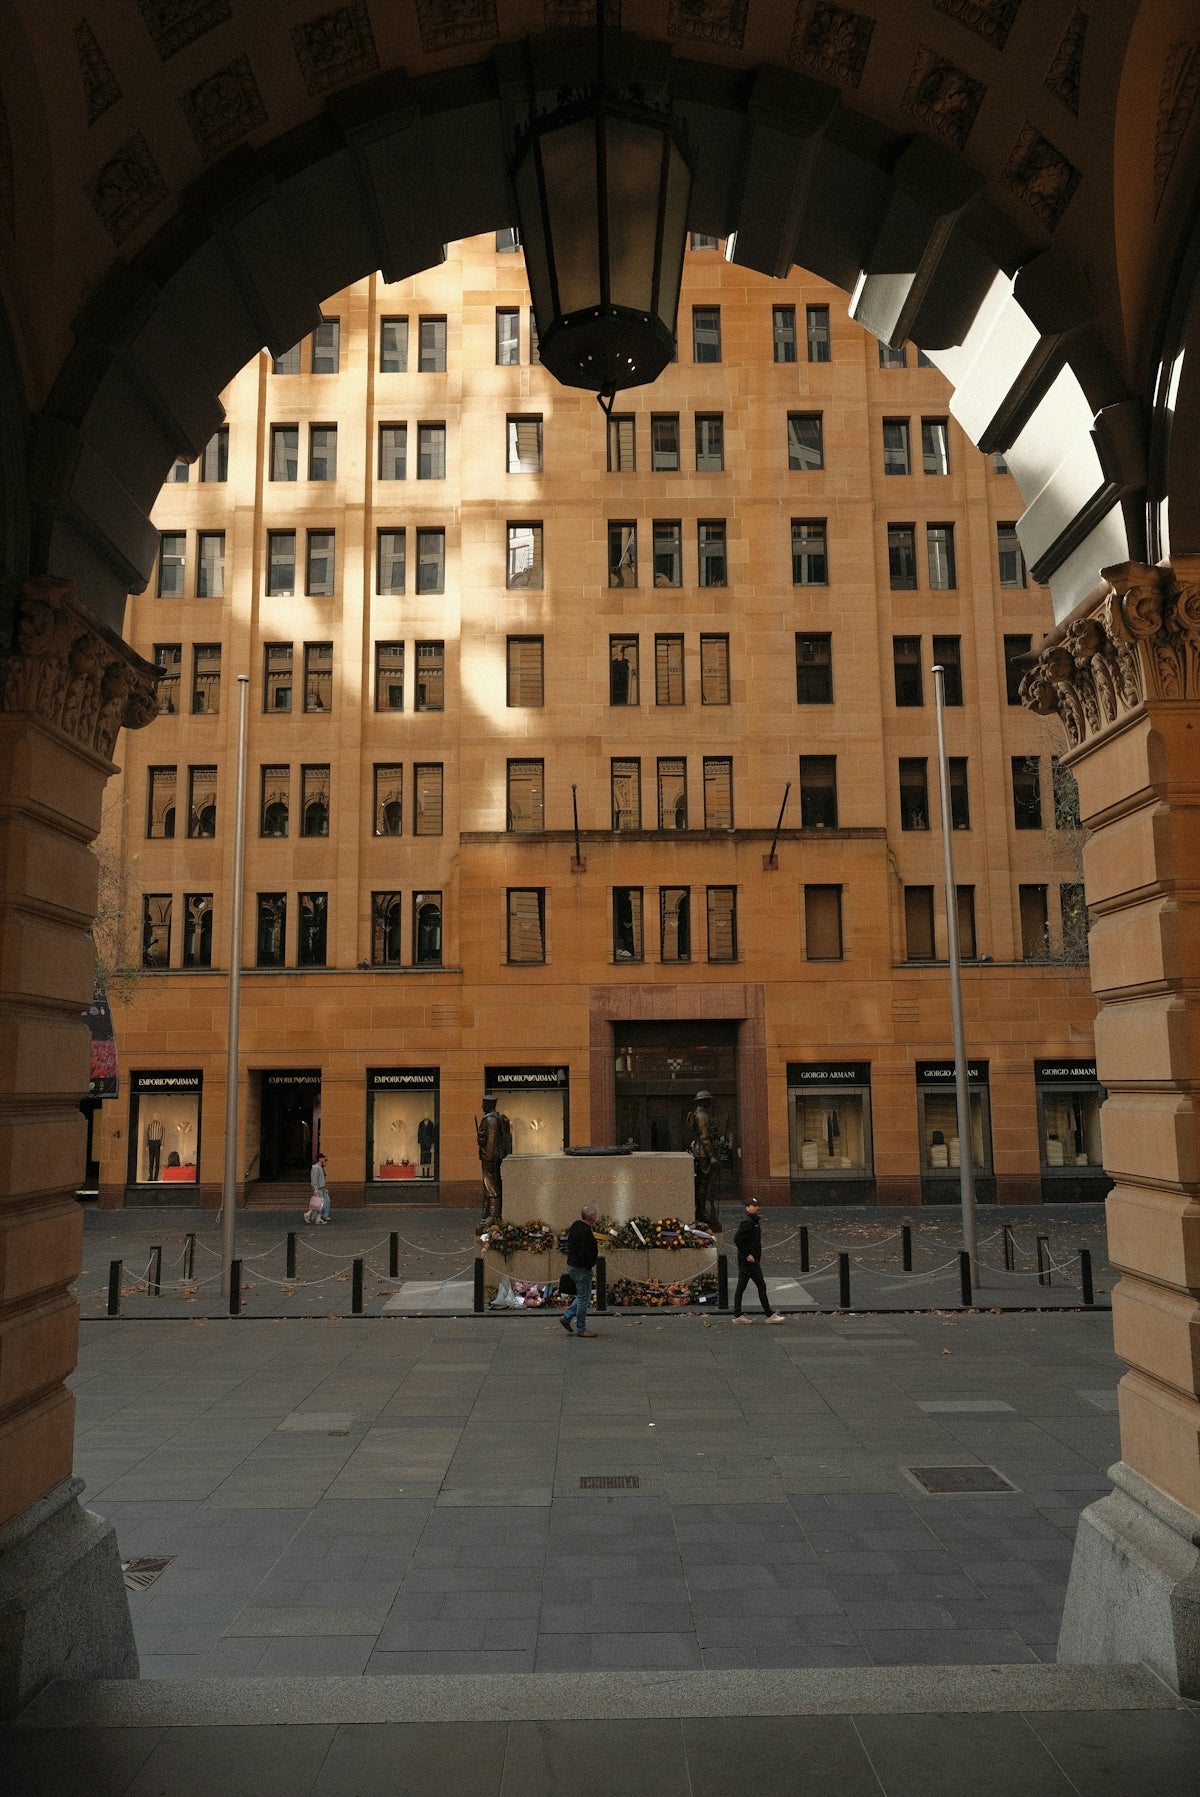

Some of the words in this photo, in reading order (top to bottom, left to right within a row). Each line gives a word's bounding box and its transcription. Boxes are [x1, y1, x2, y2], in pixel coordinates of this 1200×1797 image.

[800, 1071, 828, 1079] GIORGIO
[1041, 1068, 1069, 1076] GIORGIO
[138, 1078, 167, 1086] EMPORIO
[173, 1078, 199, 1086] ARMANI
[374, 1075, 403, 1083] EMPORIO
[409, 1075, 434, 1083] ARMANI
[497, 1074, 527, 1082] EMPORIO
[533, 1074, 558, 1082] ARMANI
